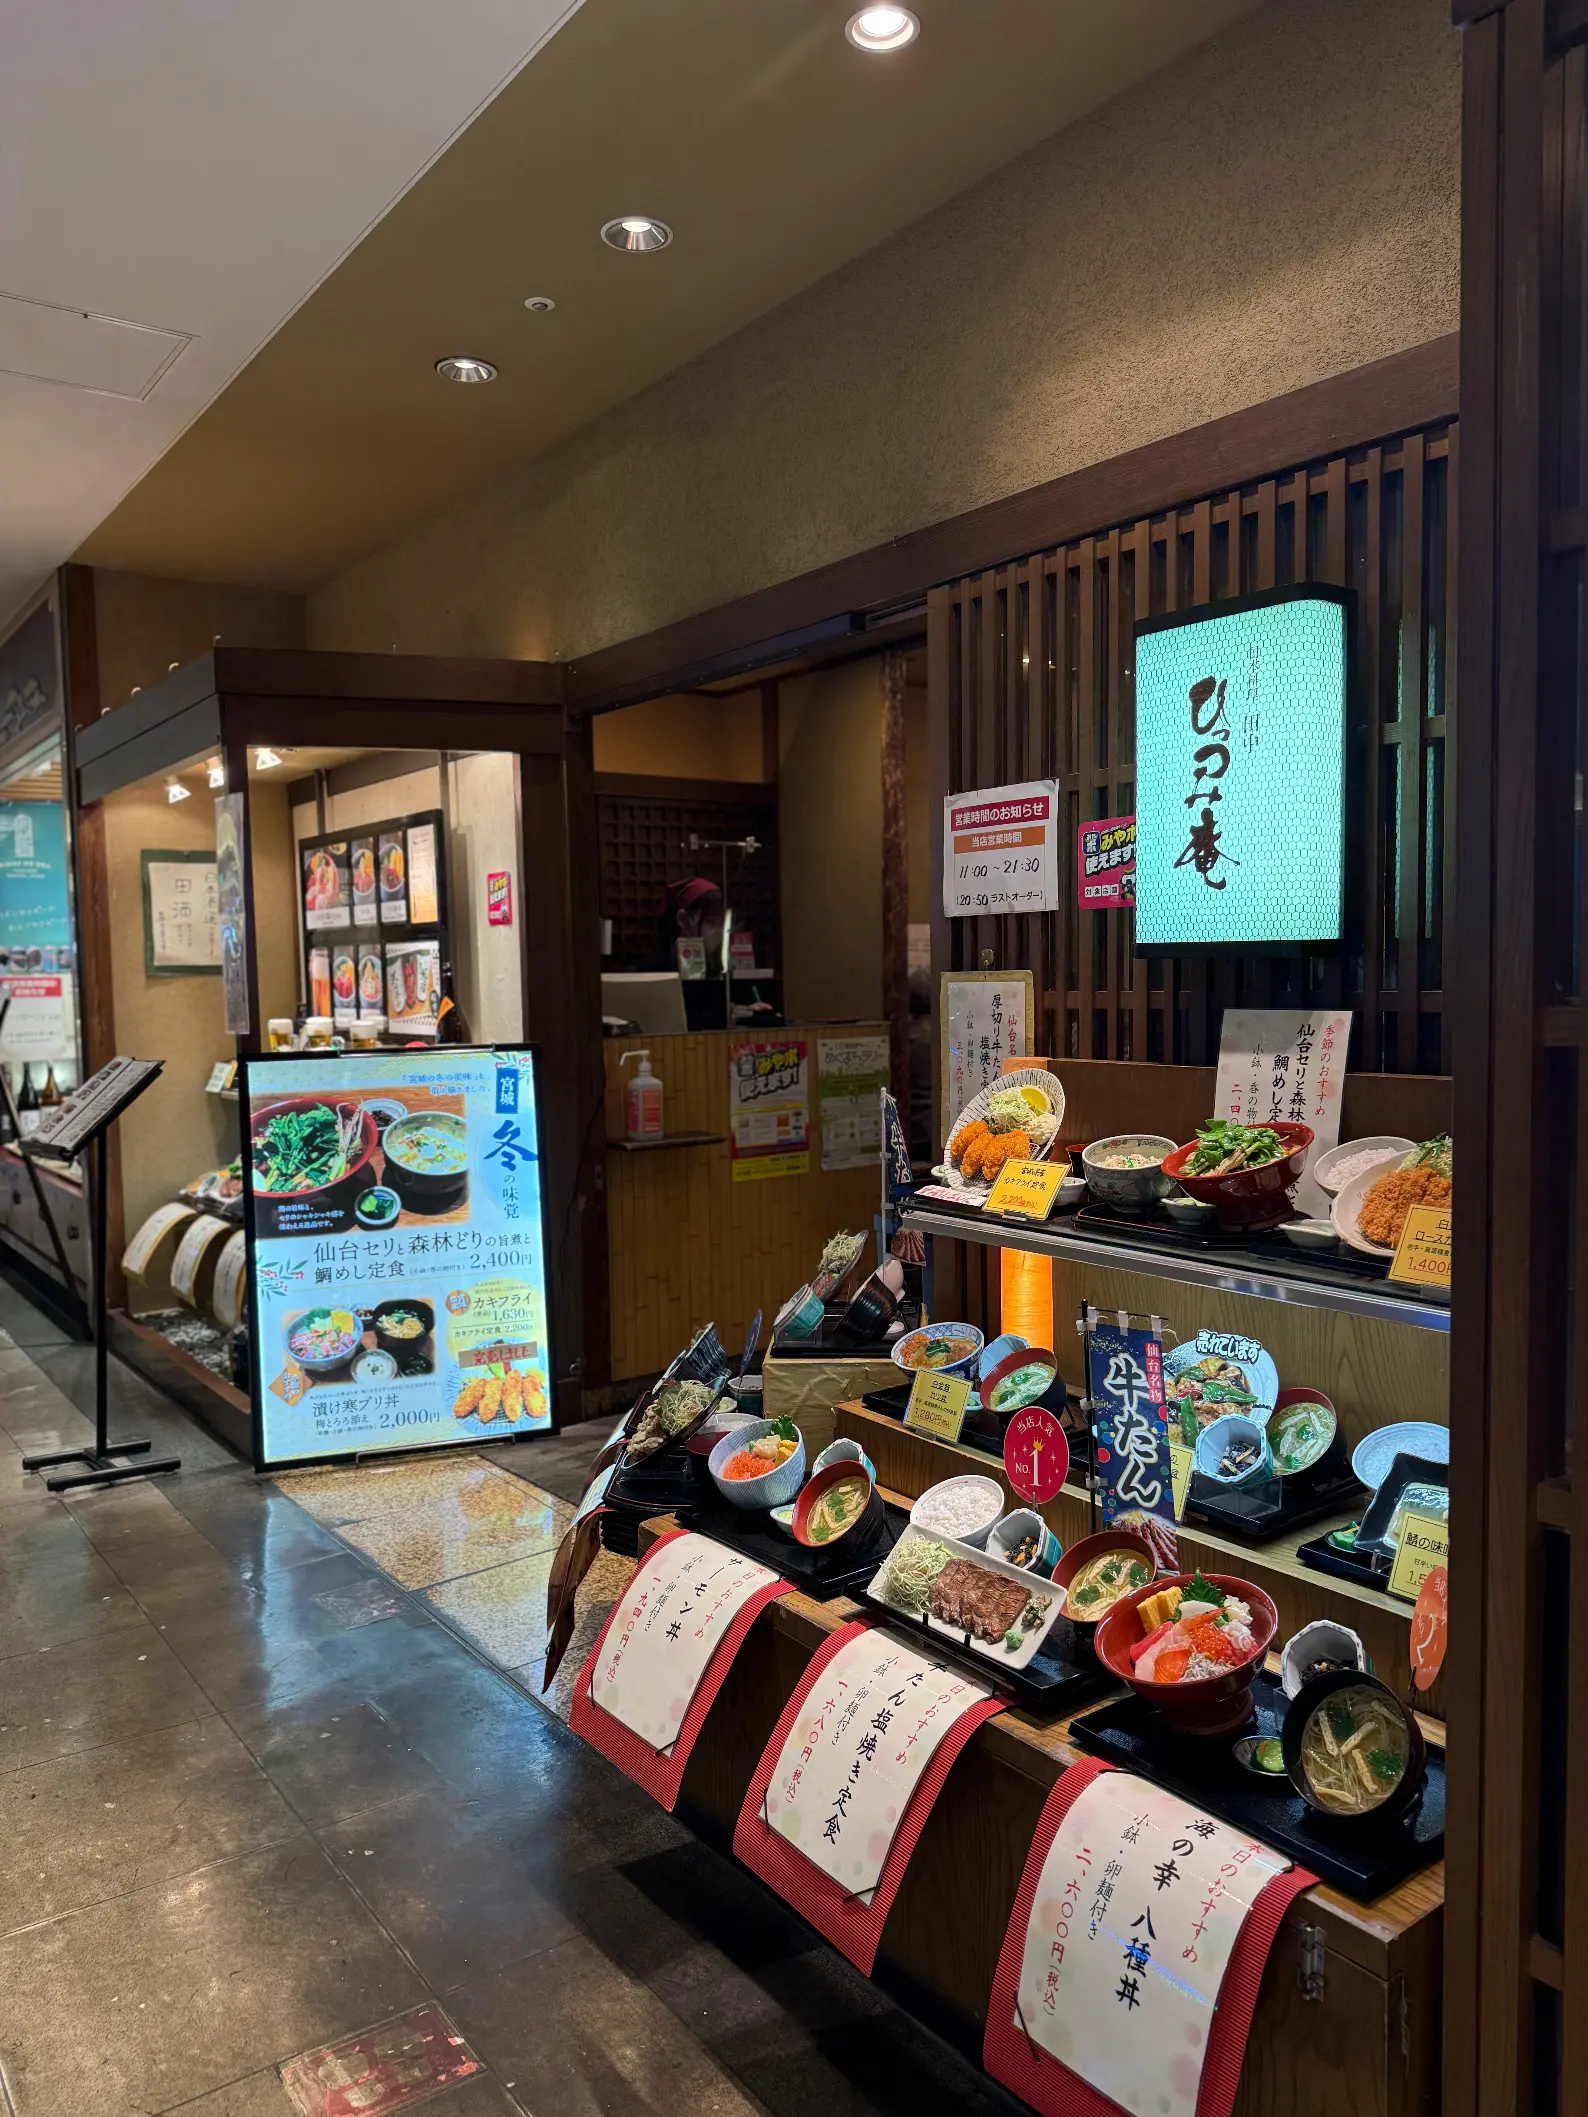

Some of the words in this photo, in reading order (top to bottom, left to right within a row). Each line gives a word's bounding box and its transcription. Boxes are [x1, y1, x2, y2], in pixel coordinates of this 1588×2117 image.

[955, 802, 1044, 827] 営業時間のお知らせ
[972, 832, 1022, 849] 当店営業時間
[959, 864, 988, 879] 11:00
[1003, 857, 1040, 874] 21:30
[1315, 1024, 1335, 1116] 季節のおすすめ
[499, 1076, 515, 1106] 宮城
[314, 1260, 406, 1284] 鯛めし定食
[469, 1250, 532, 1270] 2,400円
[473, 1292, 531, 1310] カキフライ
[493, 1307, 534, 1321] 1,630円
[1197, 1330, 1261, 1364] 売れています
[1144, 1343, 1163, 1403] 仙台名物
[312, 1393, 400, 1418] 漬け寒ブリ丼
[379, 1408, 440, 1429] 2,000円
[1017, 1415, 1055, 1437] 当店人気
[1105, 1353, 1161, 1507] 牛たん
[665, 1557, 743, 1643] サーモン丼
[822, 1661, 951, 1844] 牛たん塩焼き定食
[1153, 1818, 1220, 1892] 海の幸
[1181, 1841, 1264, 1963] 本日のおすすめ
[1115, 1905, 1157, 2011] 八種丼
